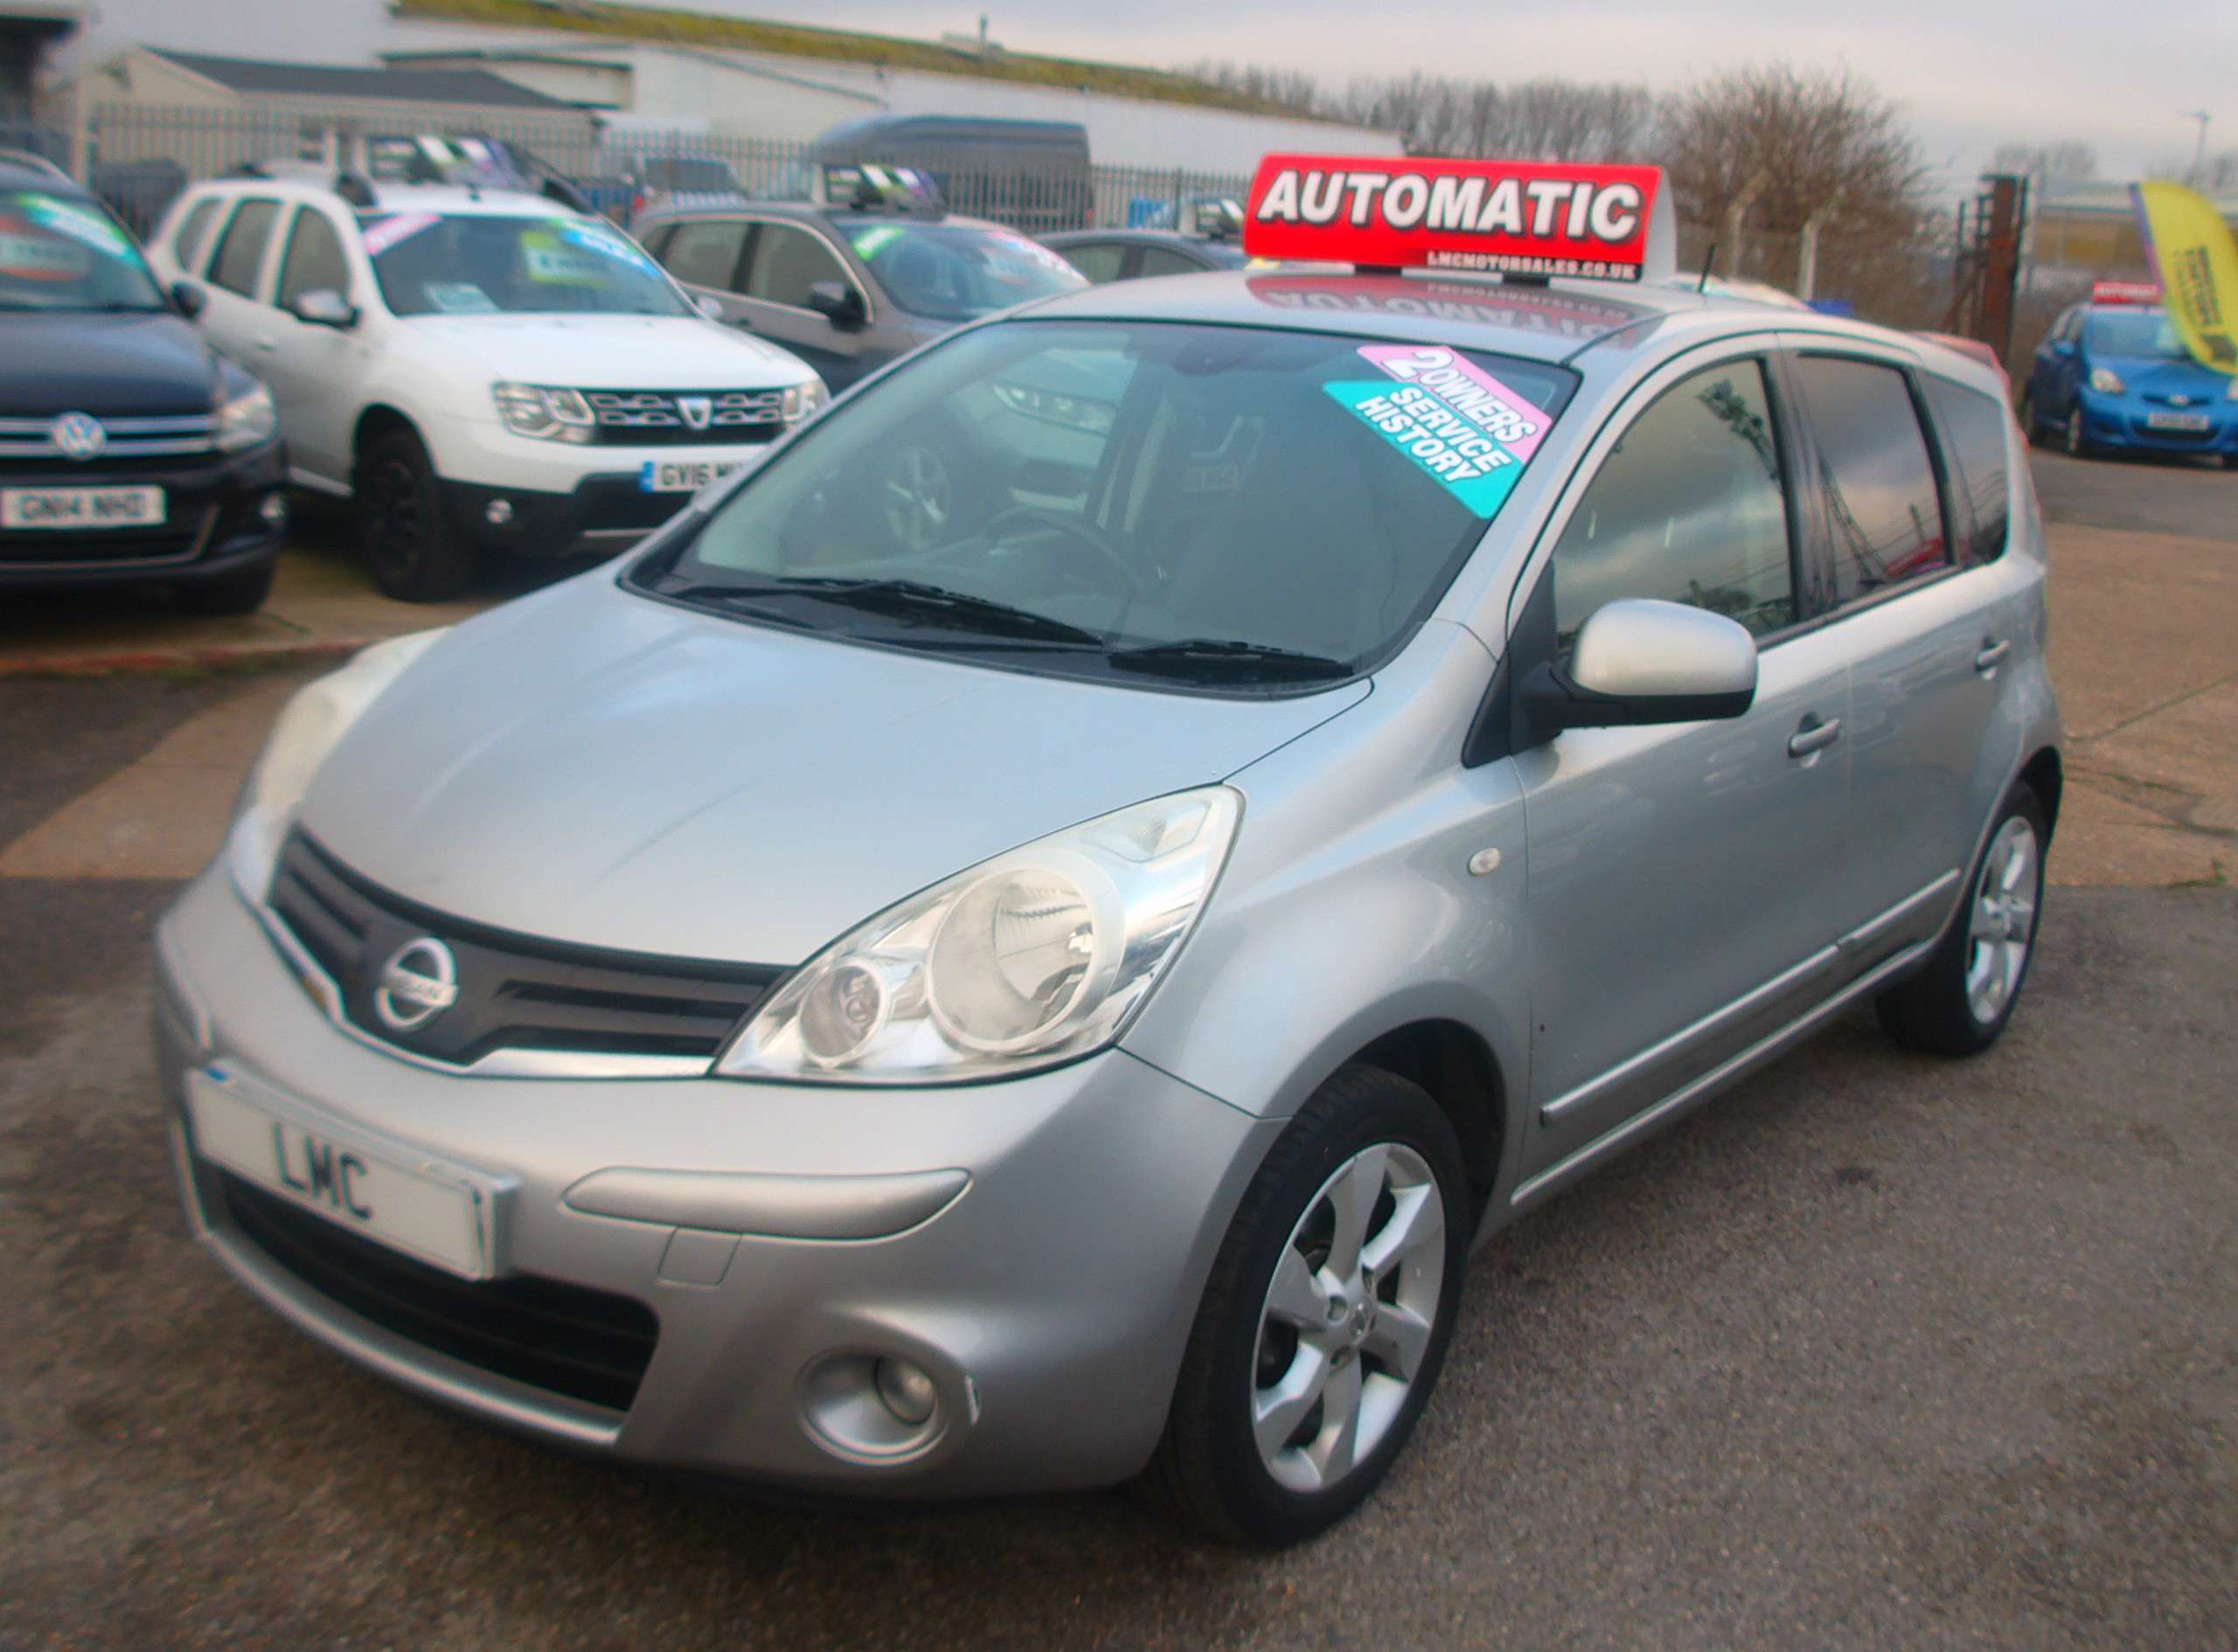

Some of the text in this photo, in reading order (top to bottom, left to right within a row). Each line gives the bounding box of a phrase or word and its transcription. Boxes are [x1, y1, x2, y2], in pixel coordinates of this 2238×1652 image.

[1255, 169, 1640, 241] AUTOMATIC
[1427, 250, 1637, 280] LMCMOTORSALES.CO.UK
[1356, 395, 1484, 482] HISTORY
[1381, 349, 1537, 443] 2 OWNERS
[1389, 386, 1512, 473] SERVICE
[273, 1121, 373, 1222] LMC
